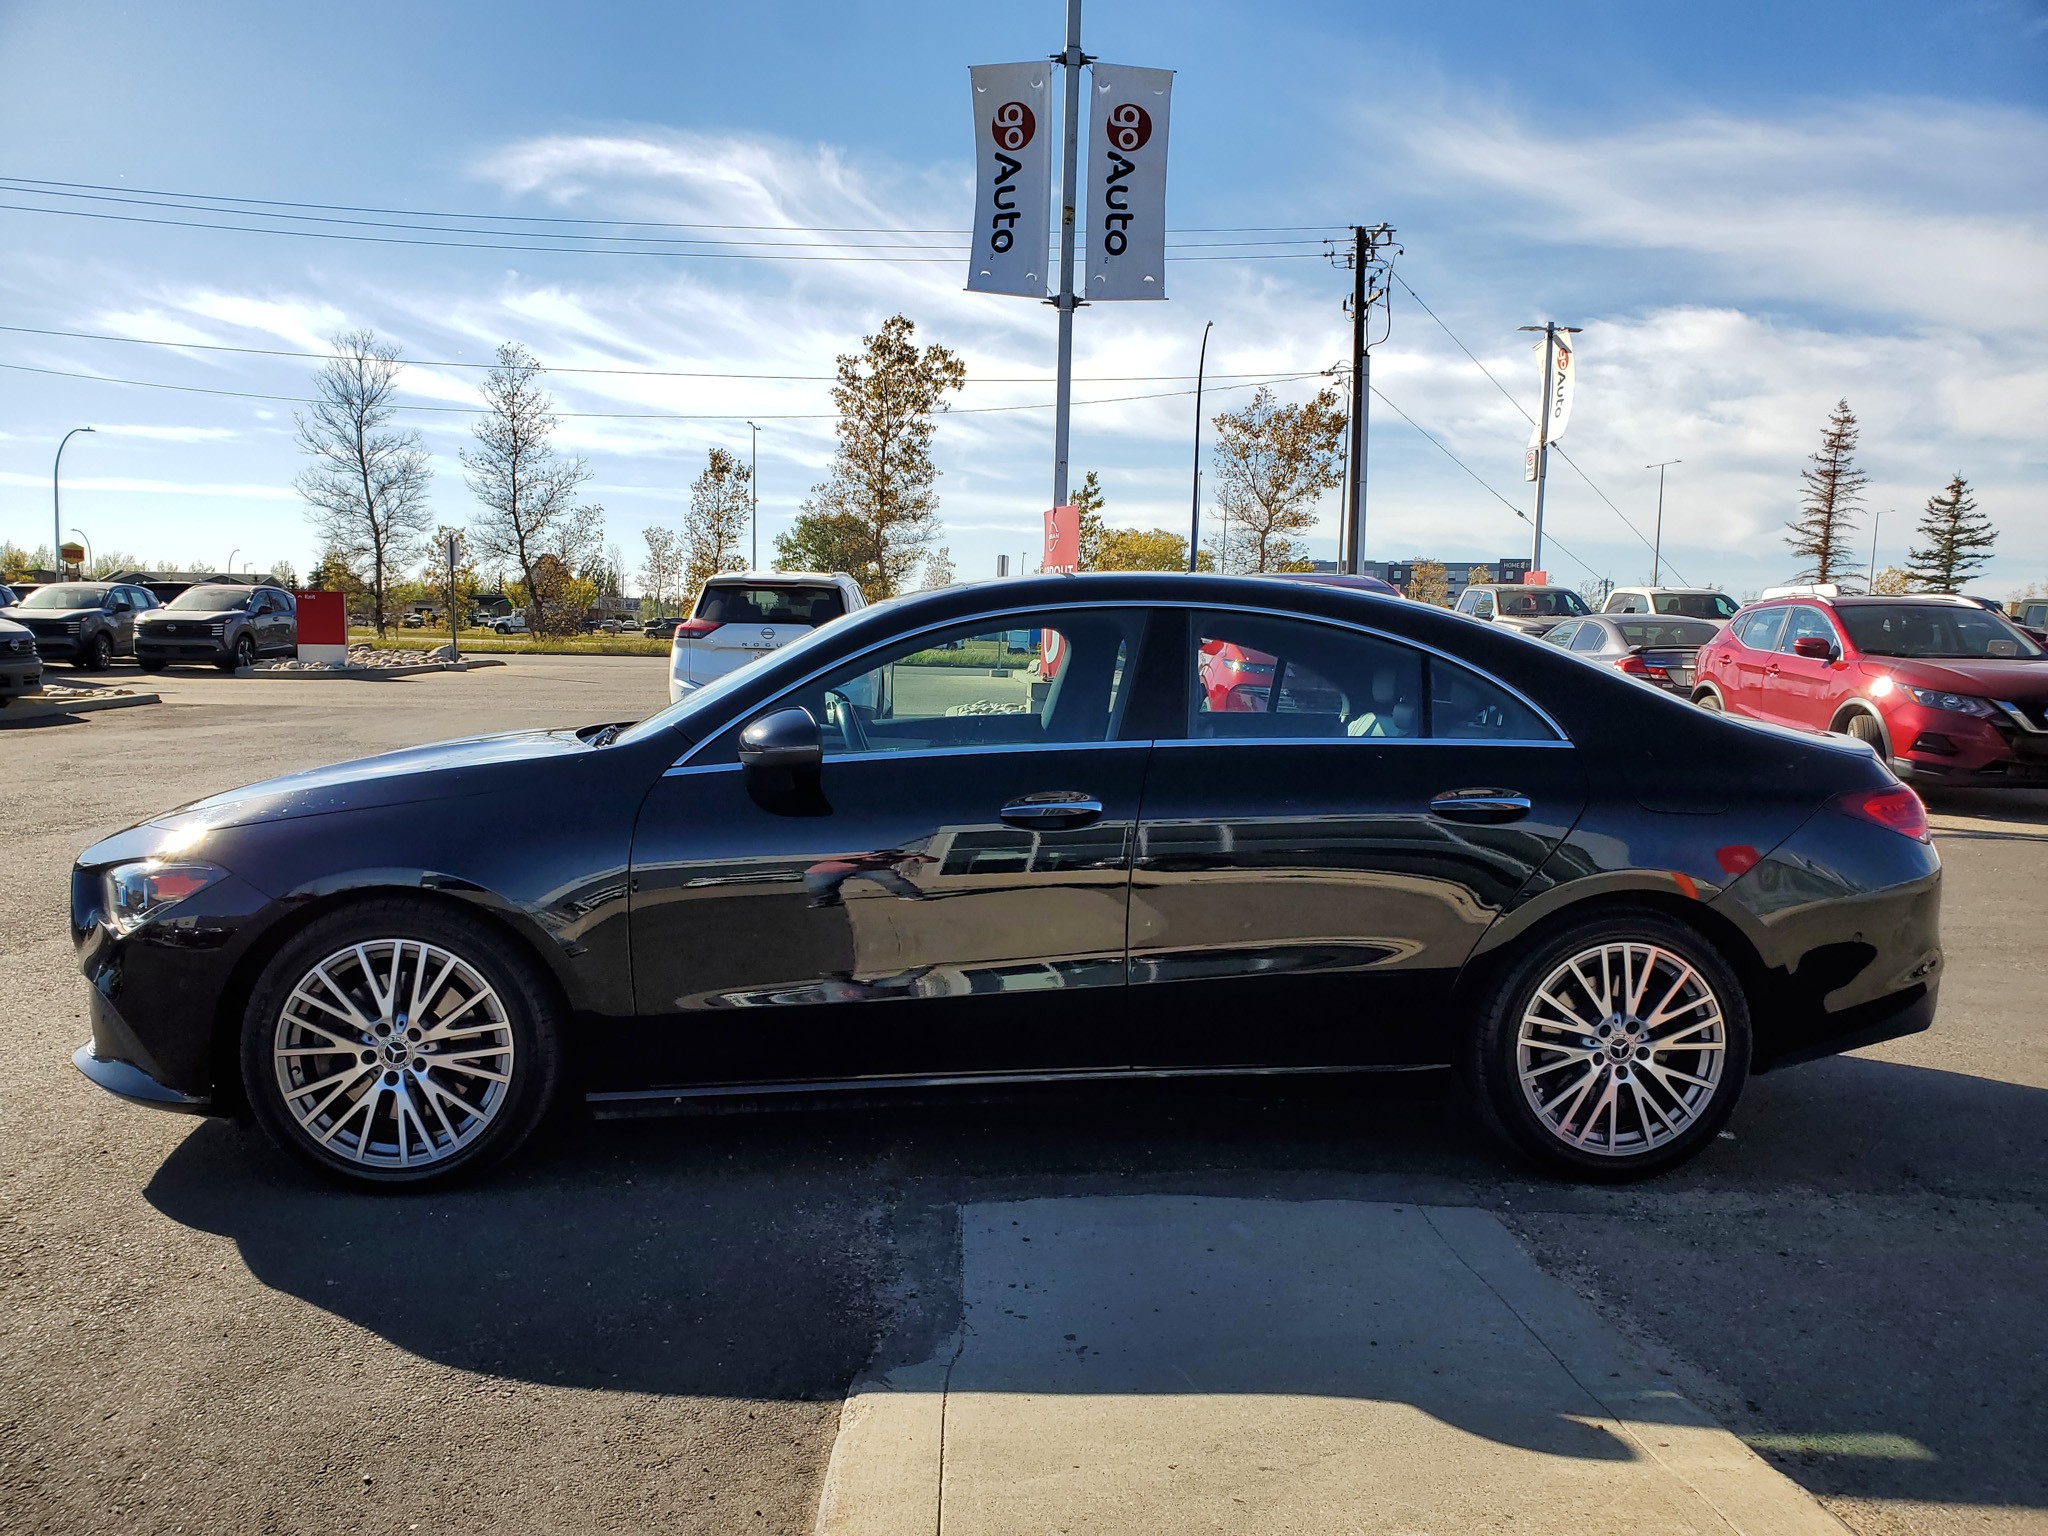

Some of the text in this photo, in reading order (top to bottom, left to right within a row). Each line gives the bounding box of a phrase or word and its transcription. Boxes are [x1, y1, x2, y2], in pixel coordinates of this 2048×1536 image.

[991, 103, 1025, 254] go Auto
[1104, 105, 1141, 256] go Auto
[1555, 371, 1566, 418] Auto
